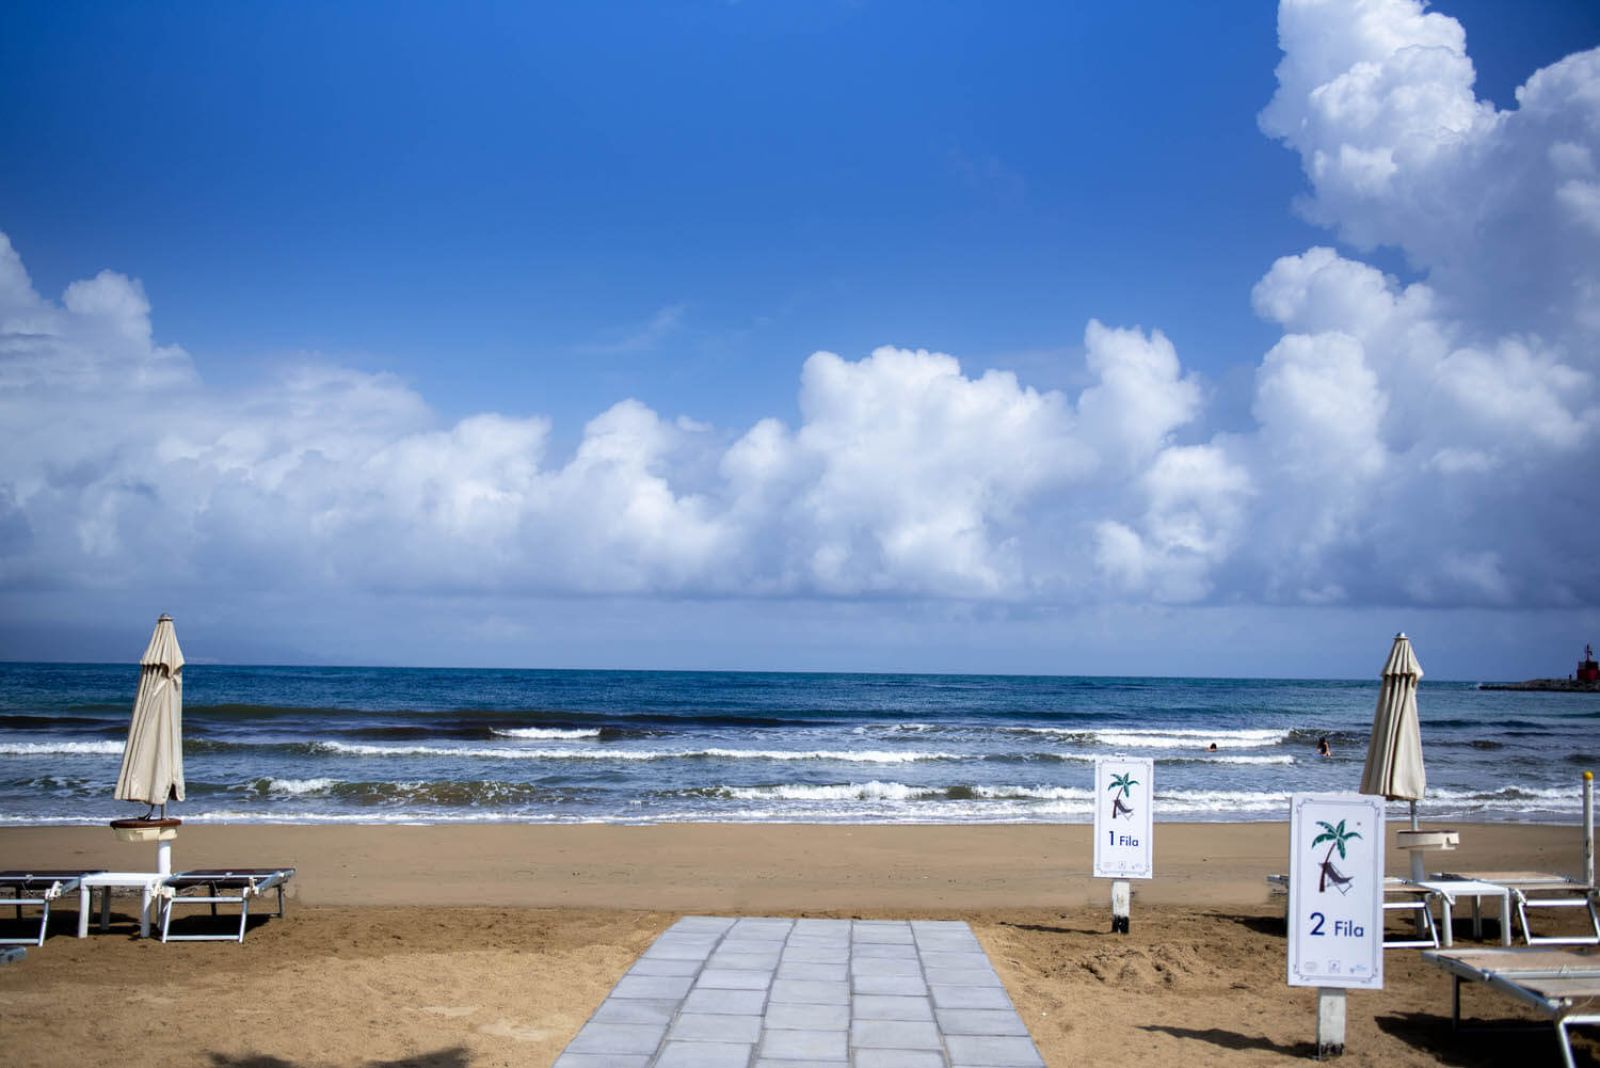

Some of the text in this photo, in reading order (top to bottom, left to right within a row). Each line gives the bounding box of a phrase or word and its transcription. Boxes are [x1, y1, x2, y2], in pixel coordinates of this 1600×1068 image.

[1109, 830, 1139, 847] 1 Fila
[1310, 911, 1365, 938] 2 Fila
